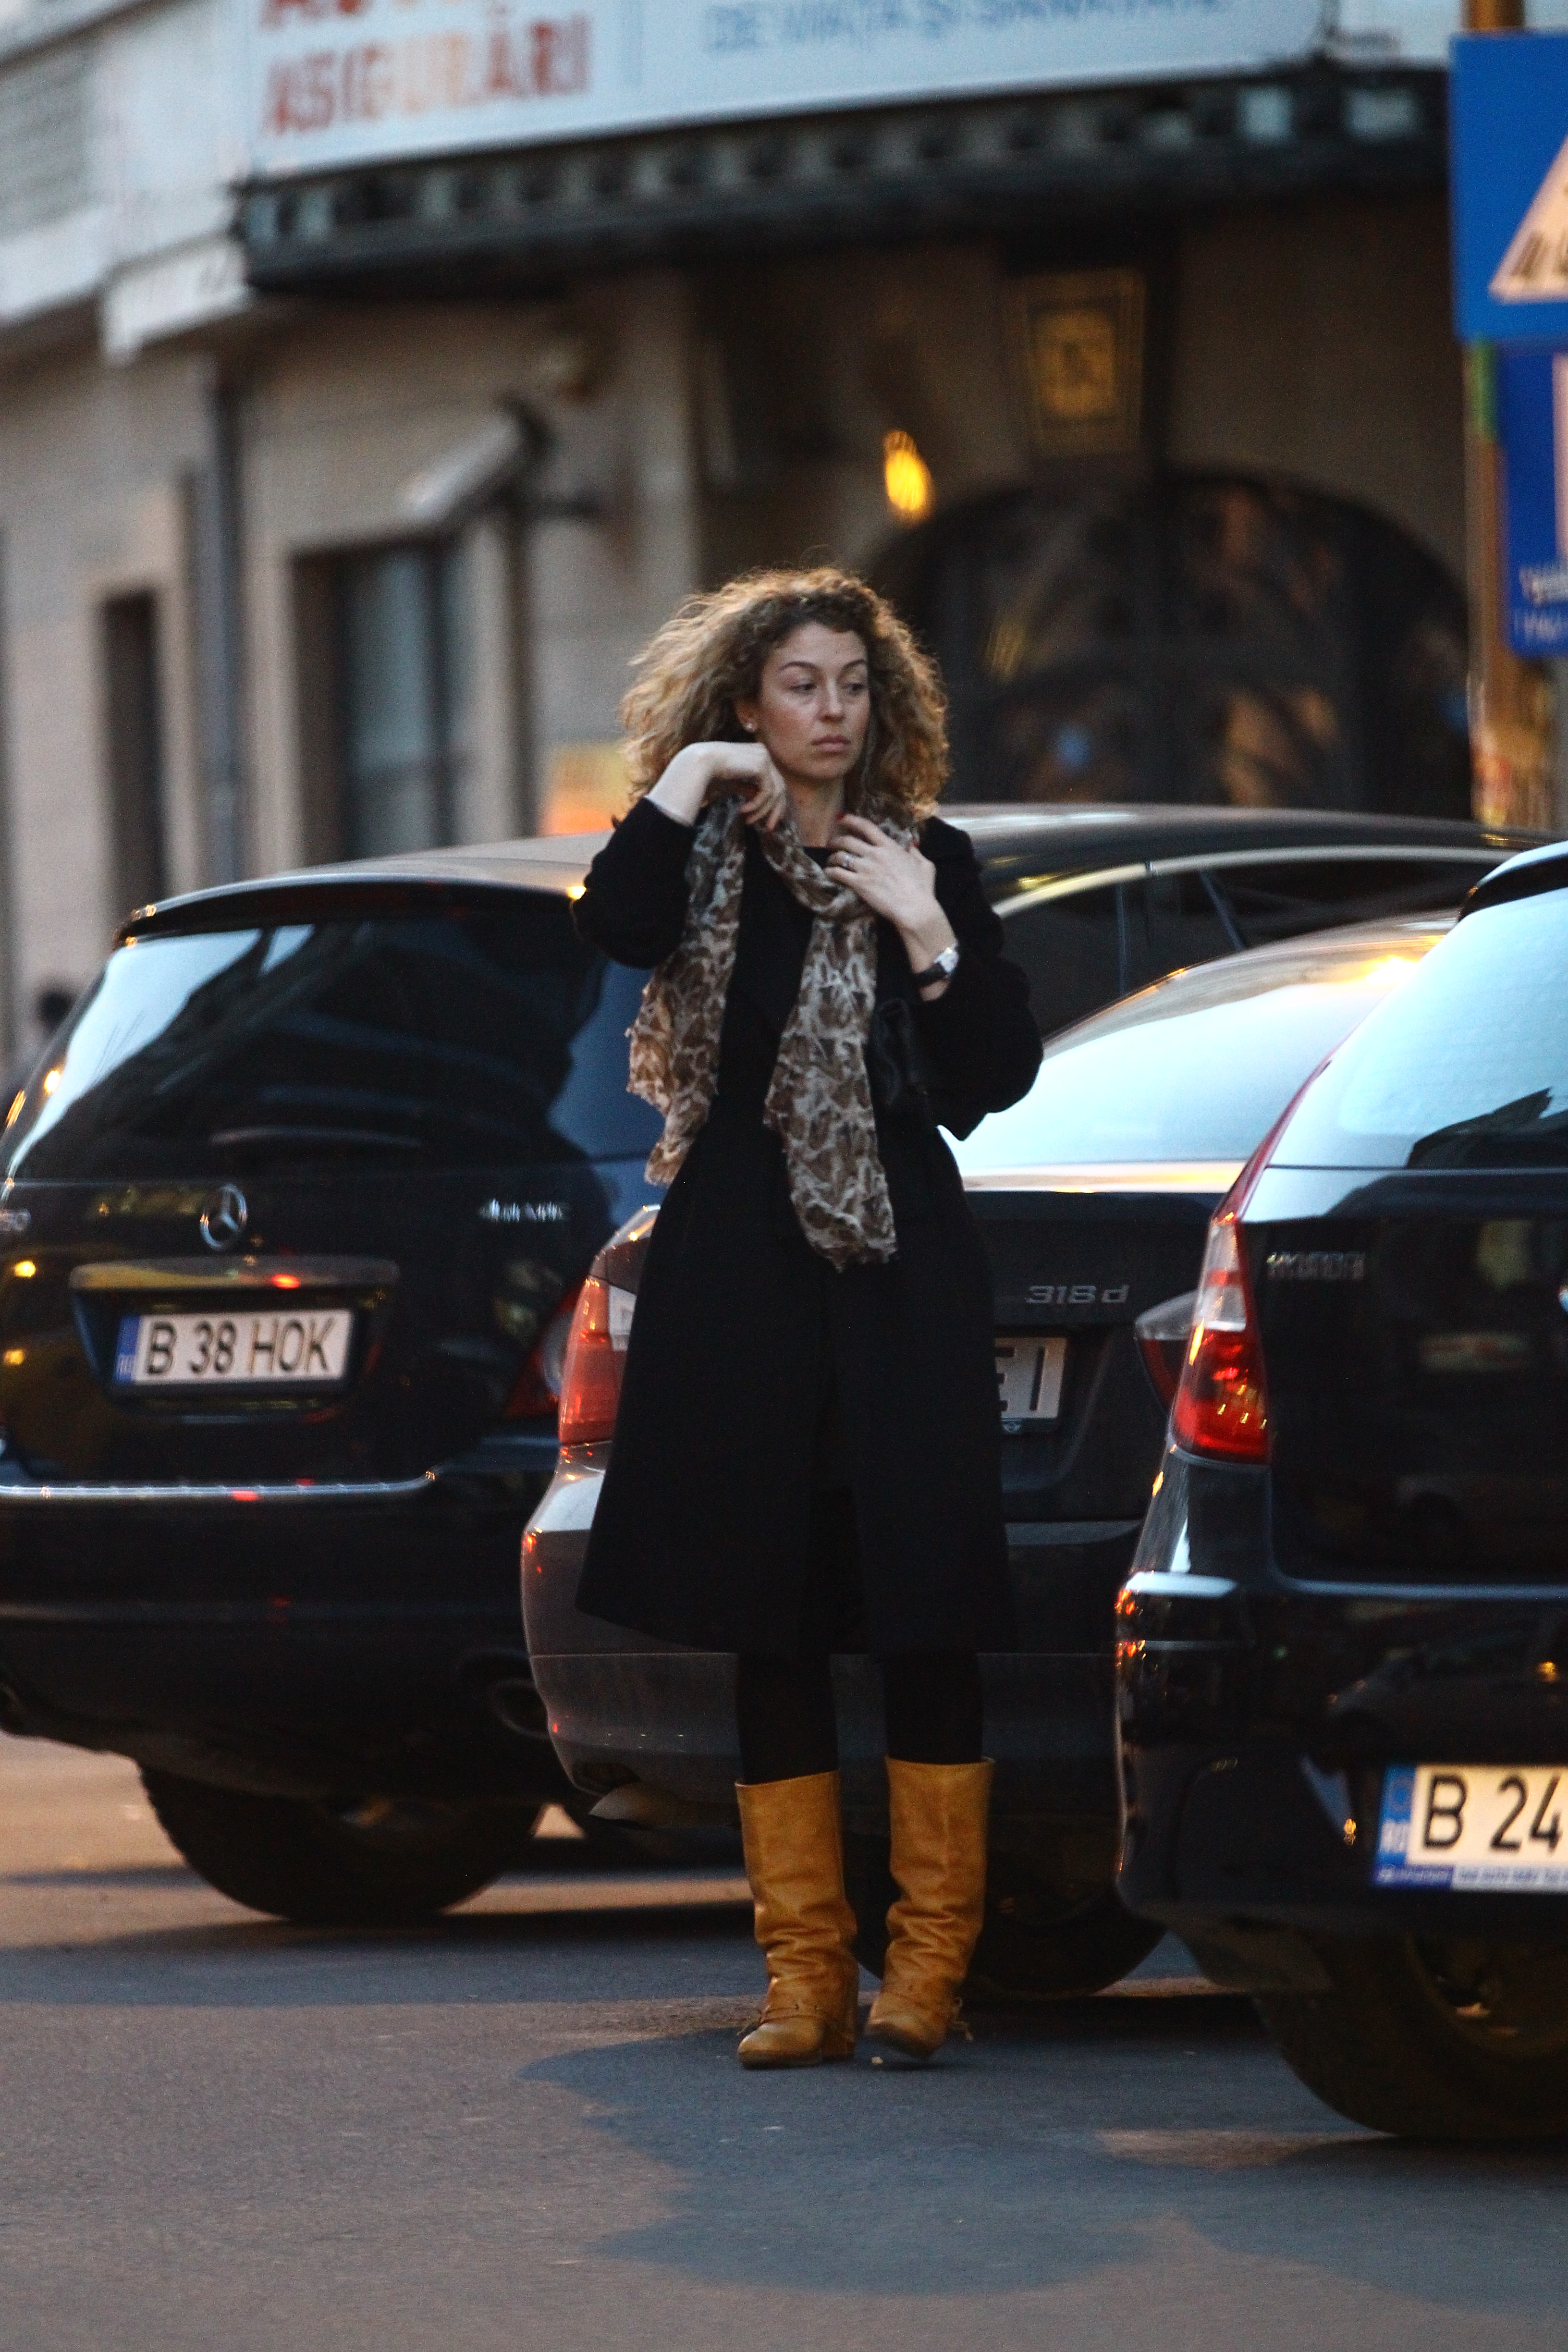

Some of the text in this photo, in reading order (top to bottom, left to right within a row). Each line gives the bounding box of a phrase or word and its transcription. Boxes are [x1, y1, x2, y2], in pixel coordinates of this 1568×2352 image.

[1026, 1284, 1130, 1304] 318d
[146, 1316, 335, 1375] B 38 HOK
[1424, 1772, 1564, 1854] B 24
